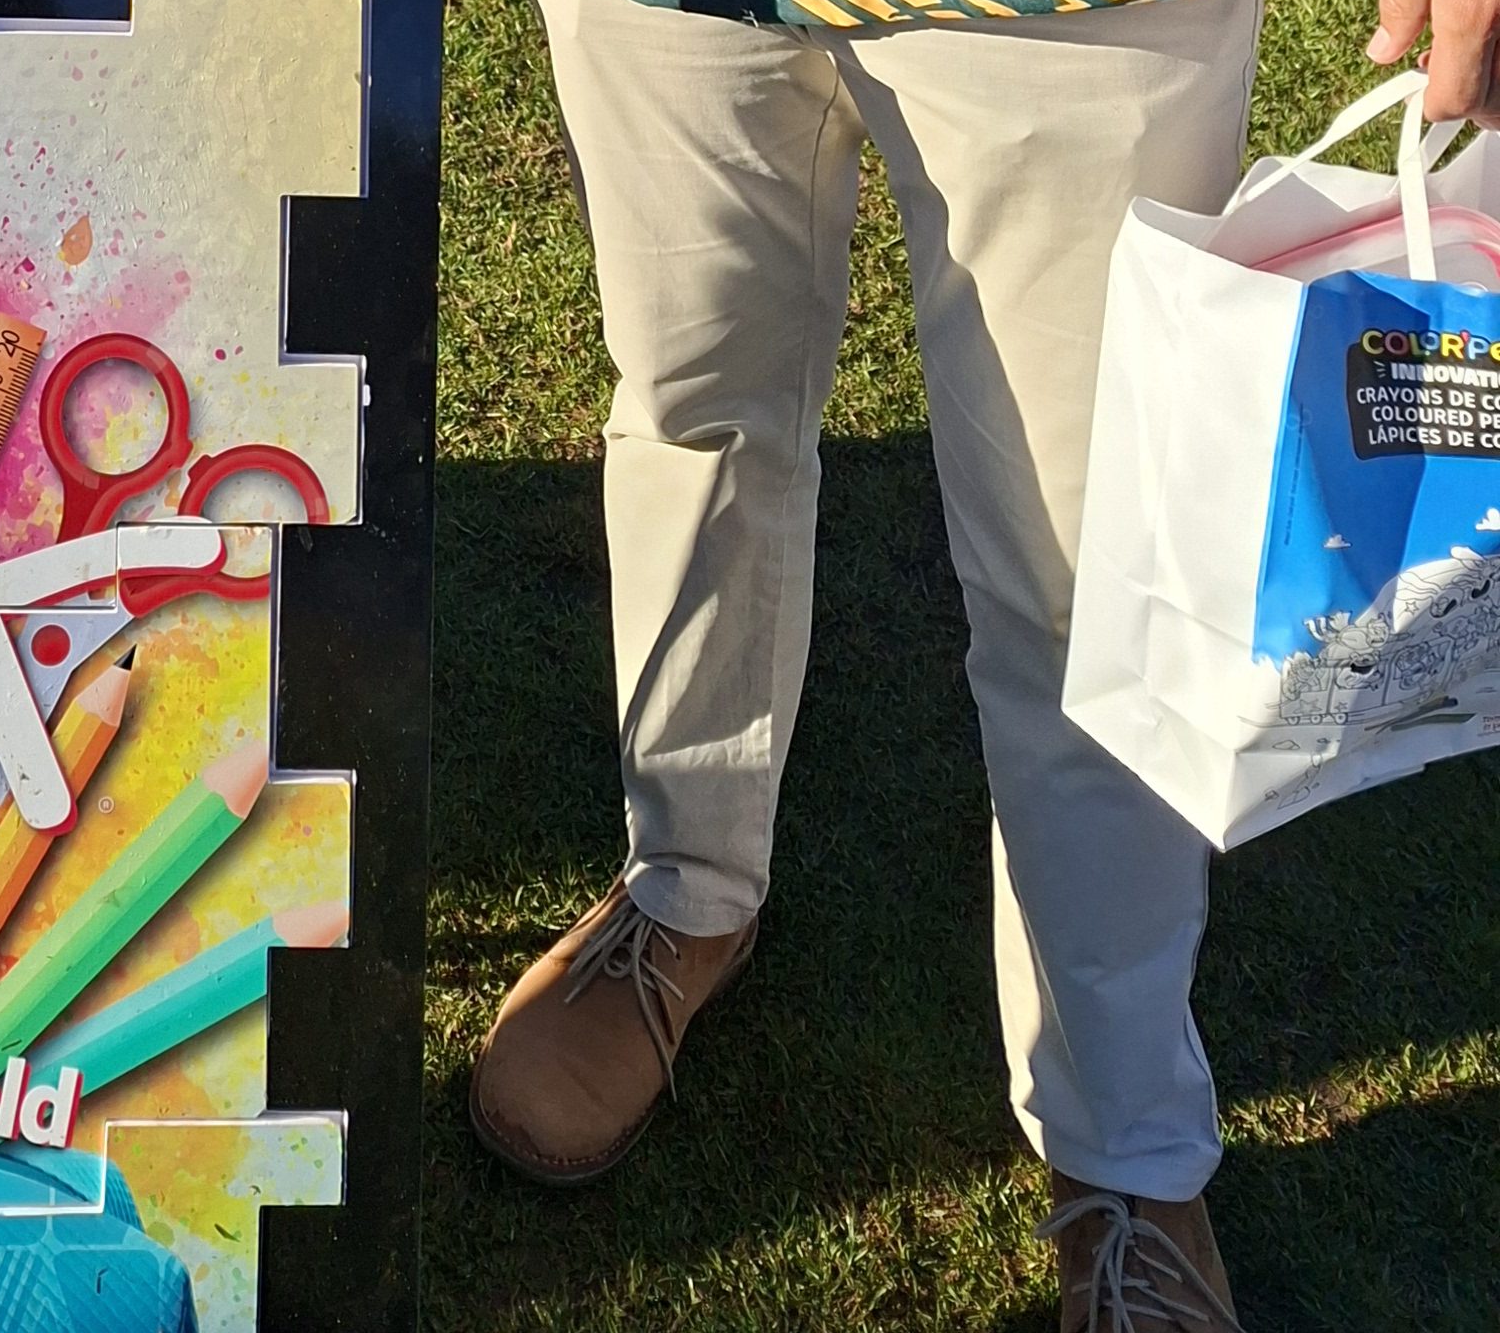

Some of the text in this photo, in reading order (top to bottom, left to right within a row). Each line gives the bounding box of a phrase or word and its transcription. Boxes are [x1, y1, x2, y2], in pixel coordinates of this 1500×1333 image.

[1390, 362, 1500, 388] INNOVATI
[1357, 386, 1444, 405] CRAYONS
[1448, 389, 1476, 408] DE
[1372, 405, 1474, 427] COLOURED
[1368, 424, 1442, 445] LÁPICES
[1447, 429, 1475, 448] DE
